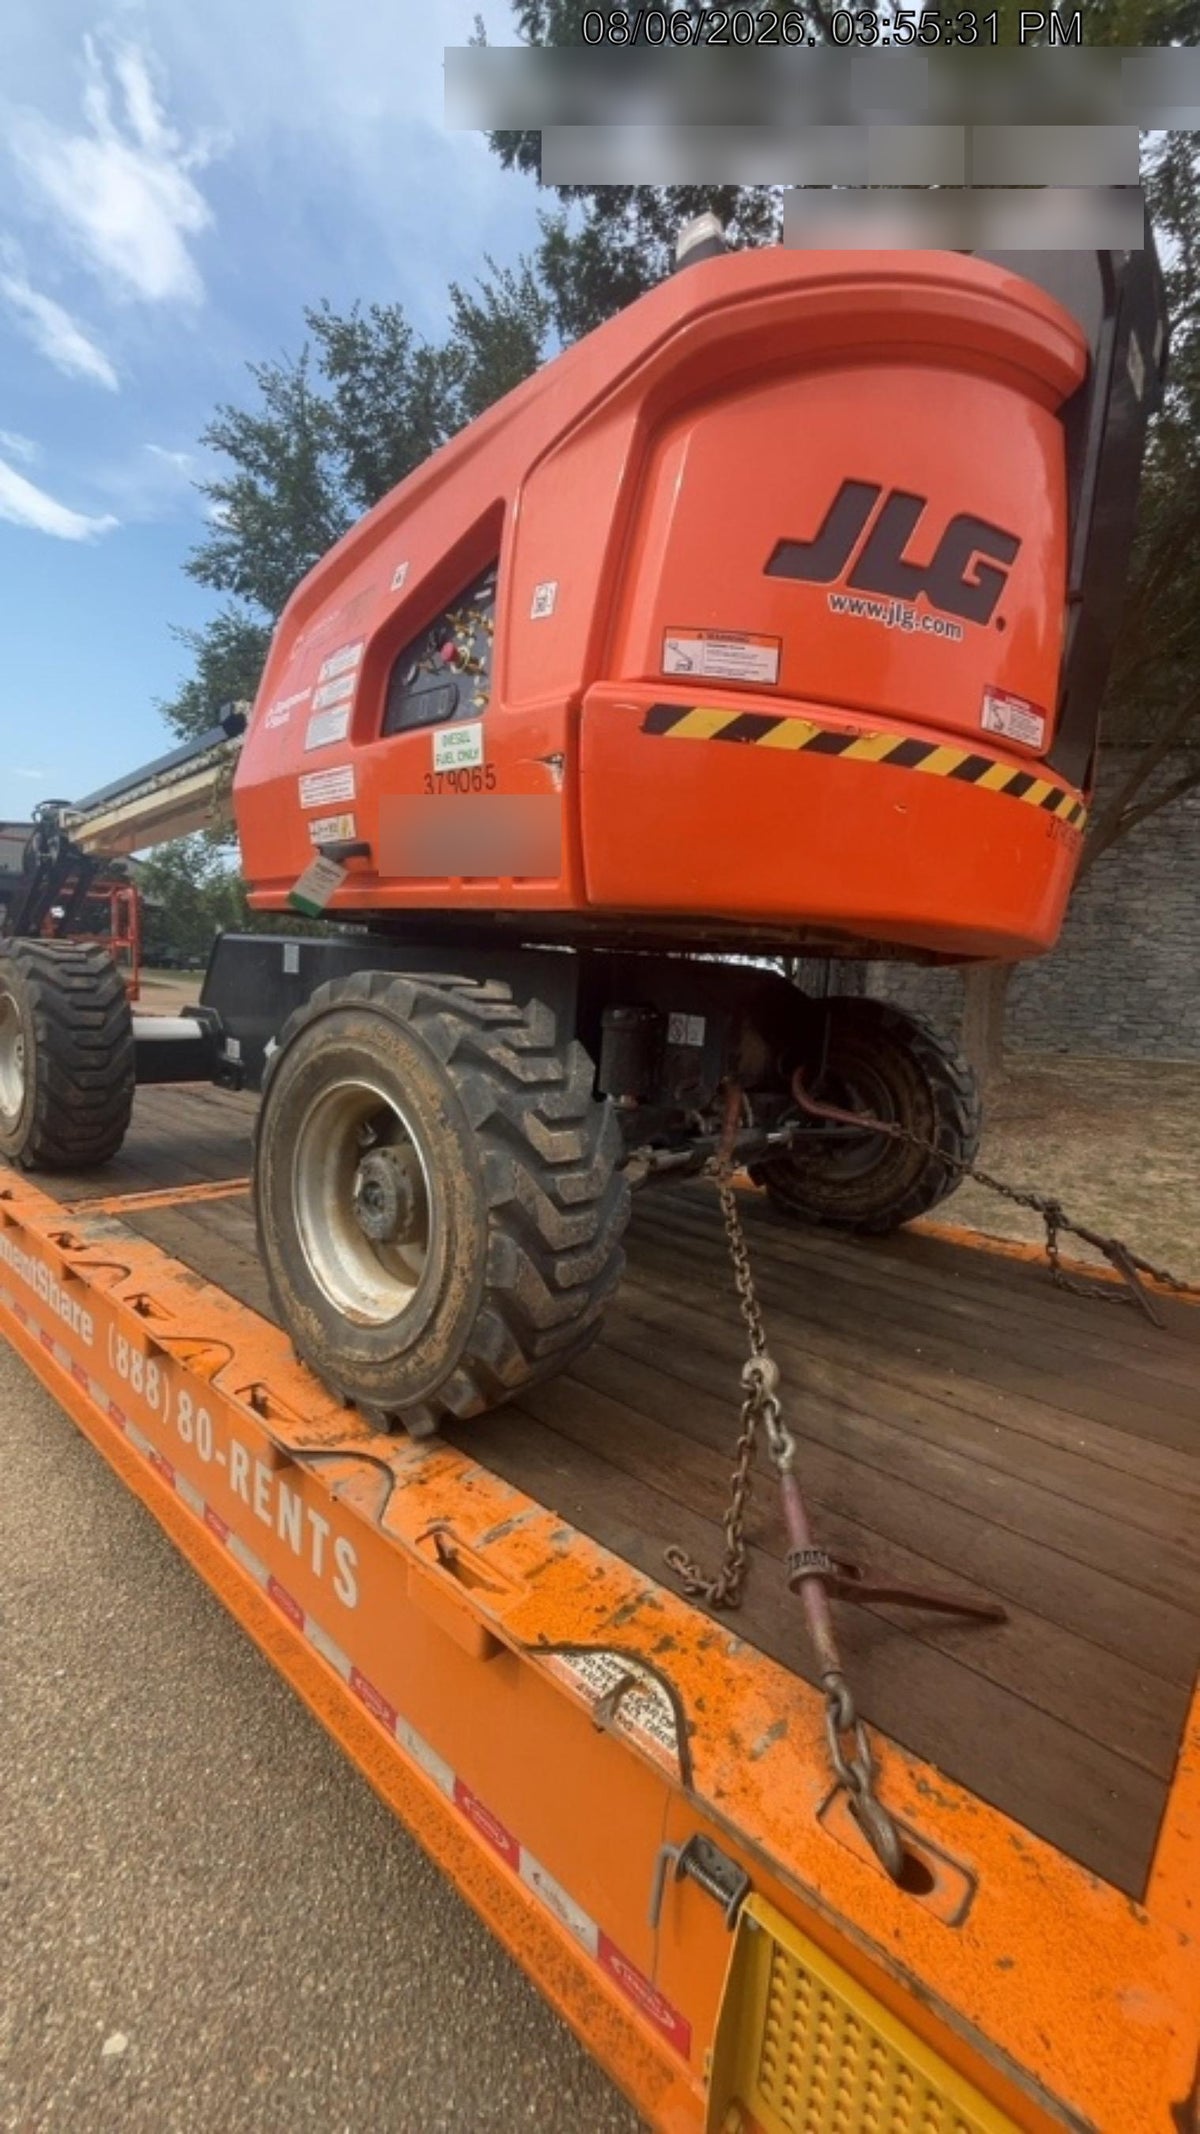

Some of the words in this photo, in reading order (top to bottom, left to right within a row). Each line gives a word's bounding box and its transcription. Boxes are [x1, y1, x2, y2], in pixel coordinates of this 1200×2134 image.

[764, 477, 1022, 627] JLG
[828, 593, 963, 642] www.jlg.com
[423, 762, 497, 795] 379065
[436, 750, 456, 766] FUEL
[108, 1321, 170, 1424] (888)
[177, 1388, 358, 1609] 80-RENTS
